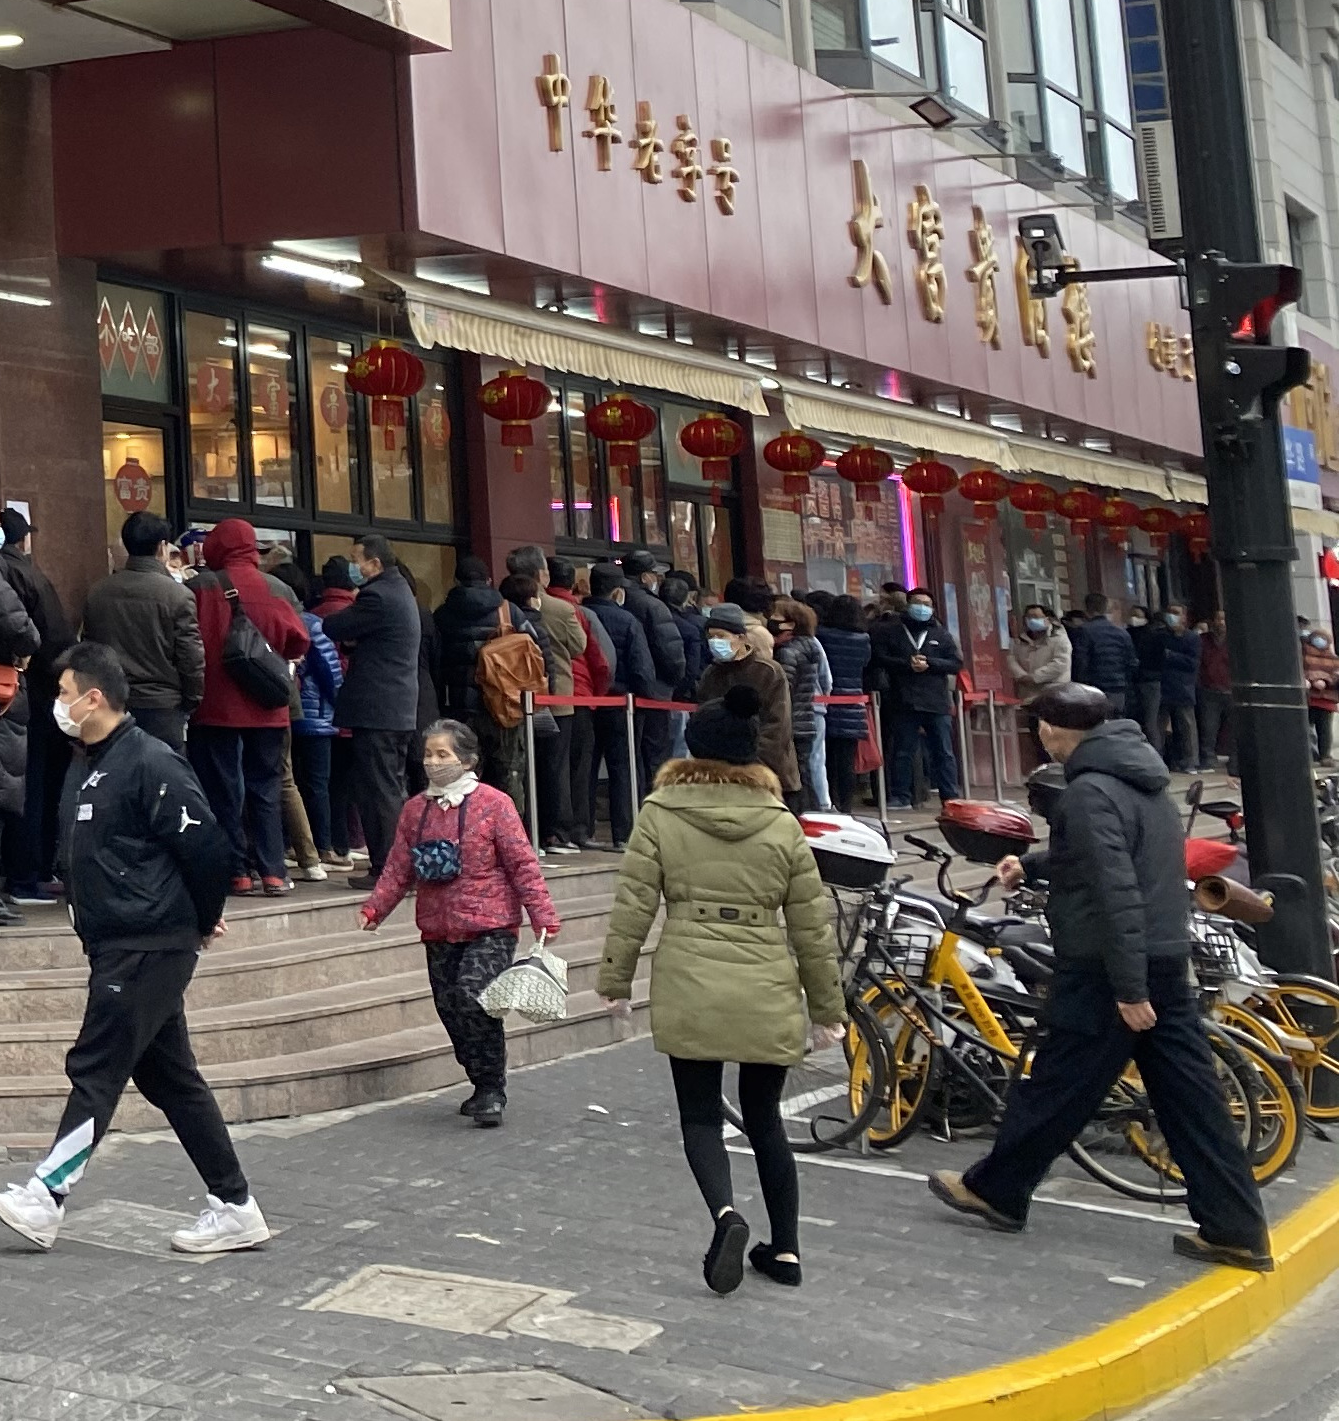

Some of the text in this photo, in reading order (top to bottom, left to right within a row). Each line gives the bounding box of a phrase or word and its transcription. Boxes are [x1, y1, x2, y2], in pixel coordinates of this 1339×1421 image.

[535, 52, 741, 216] 中华老字号
[117, 475, 150, 501] 富贵
